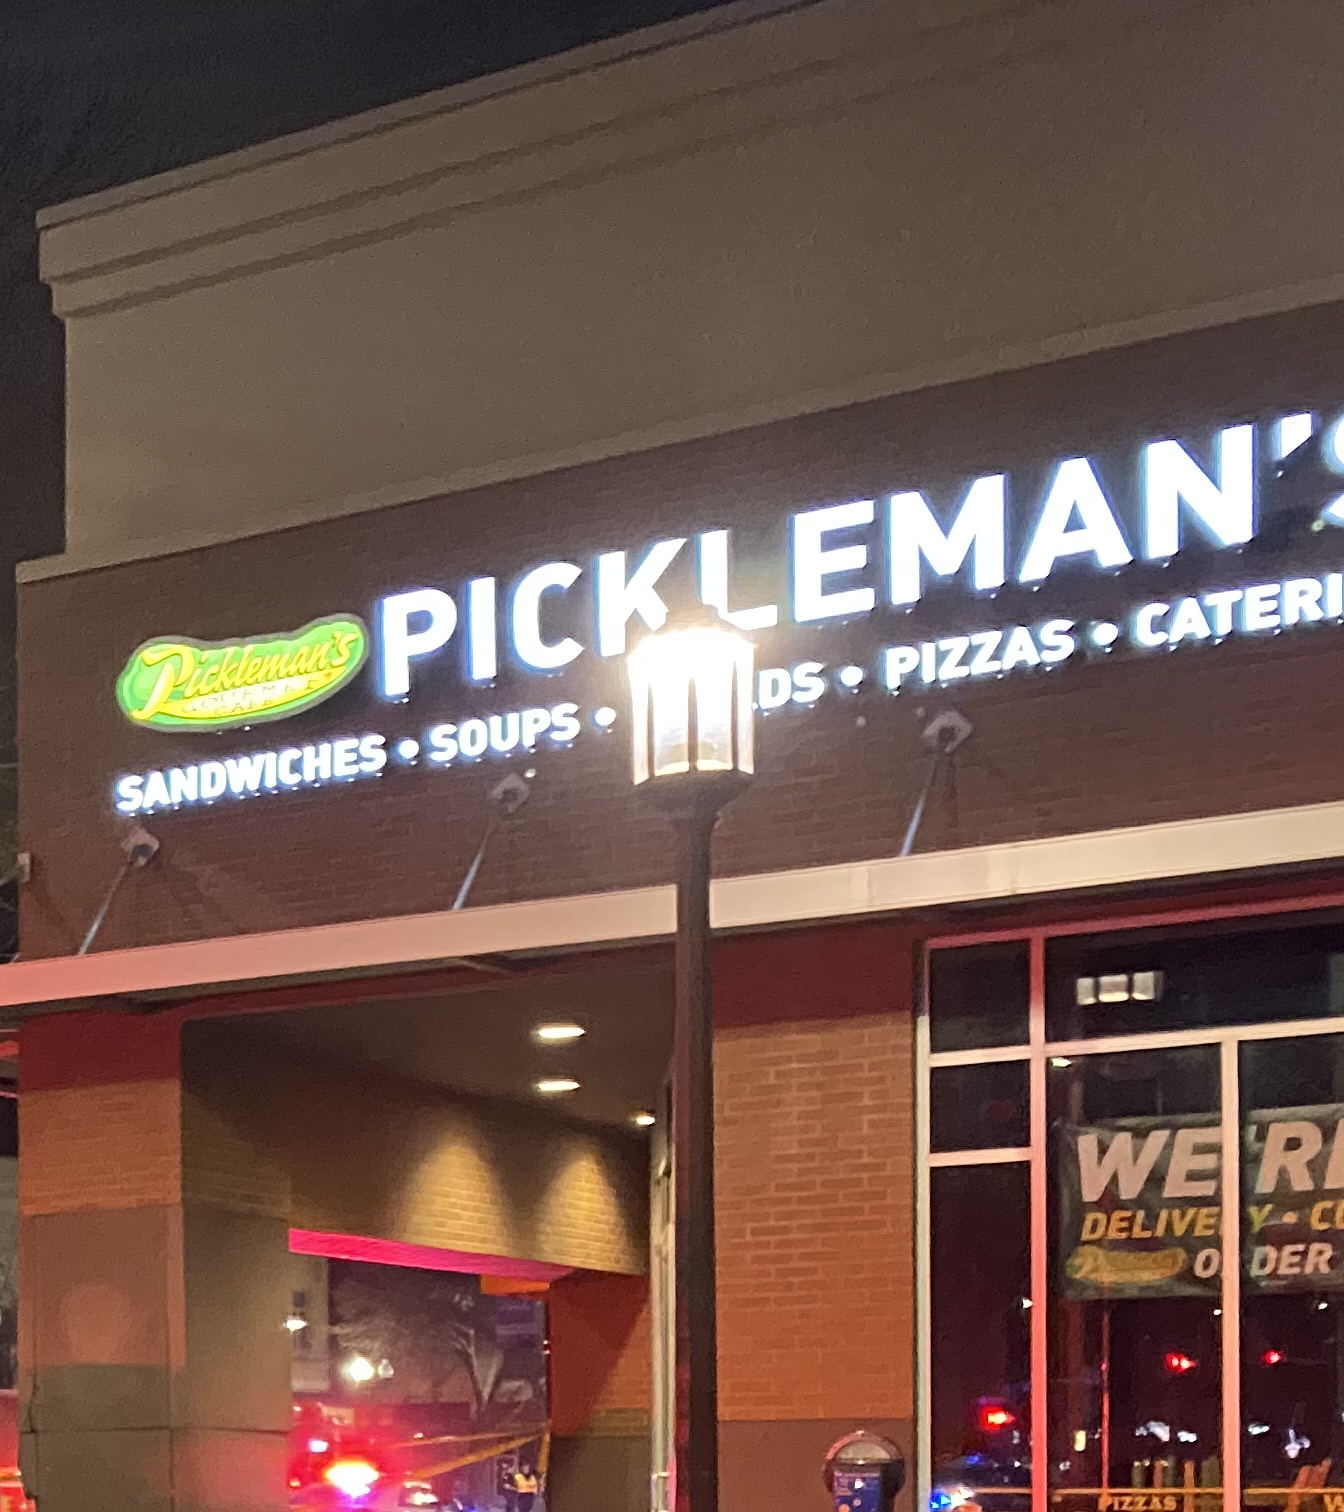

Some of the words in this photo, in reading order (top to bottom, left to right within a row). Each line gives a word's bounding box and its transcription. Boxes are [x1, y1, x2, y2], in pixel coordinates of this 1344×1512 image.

[132, 631, 360, 720] Pickleman's
[115, 734, 388, 814] SANDWICHES
[428, 701, 581, 763] SOUPS
[884, 617, 1077, 692] PIZZAS
[1080, 1204, 1275, 1243] DELIVEY
[1192, 1242, 1335, 1279] ODER
